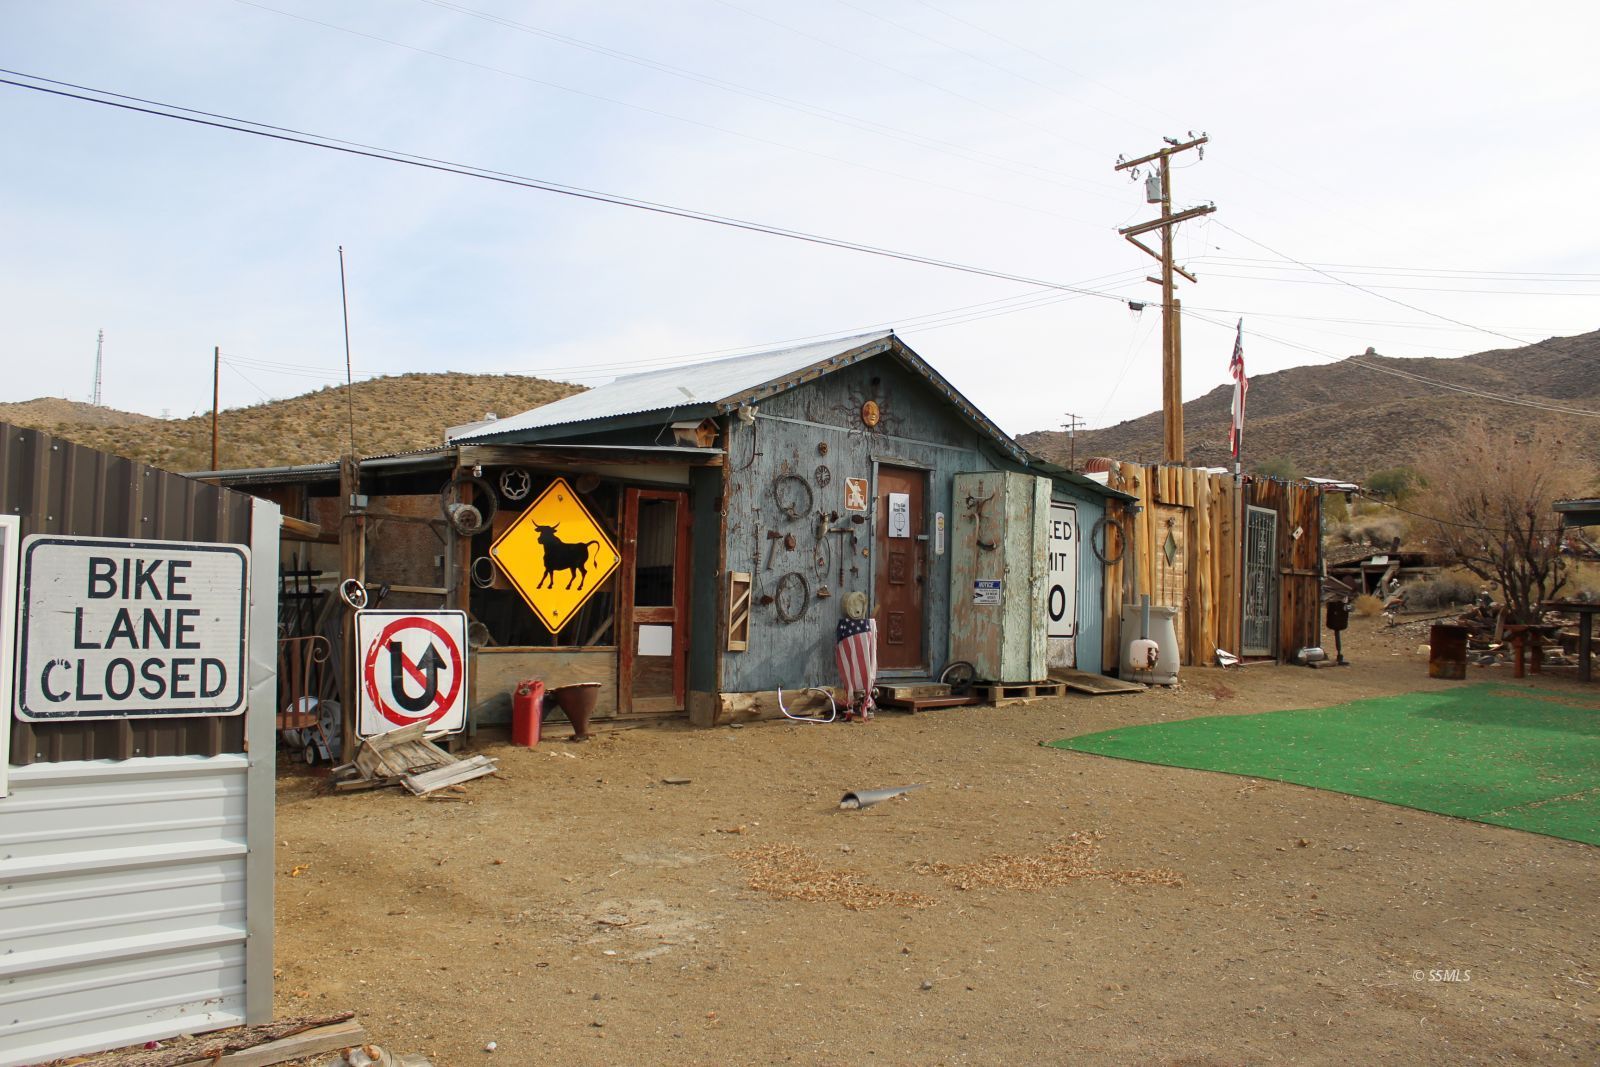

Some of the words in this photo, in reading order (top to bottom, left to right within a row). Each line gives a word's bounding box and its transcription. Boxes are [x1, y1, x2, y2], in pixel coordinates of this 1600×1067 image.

[1049, 519, 1072, 541] ED
[88, 556, 192, 601] BIKE
[74, 607, 201, 650] LANE
[40, 657, 228, 703] CLOSED
